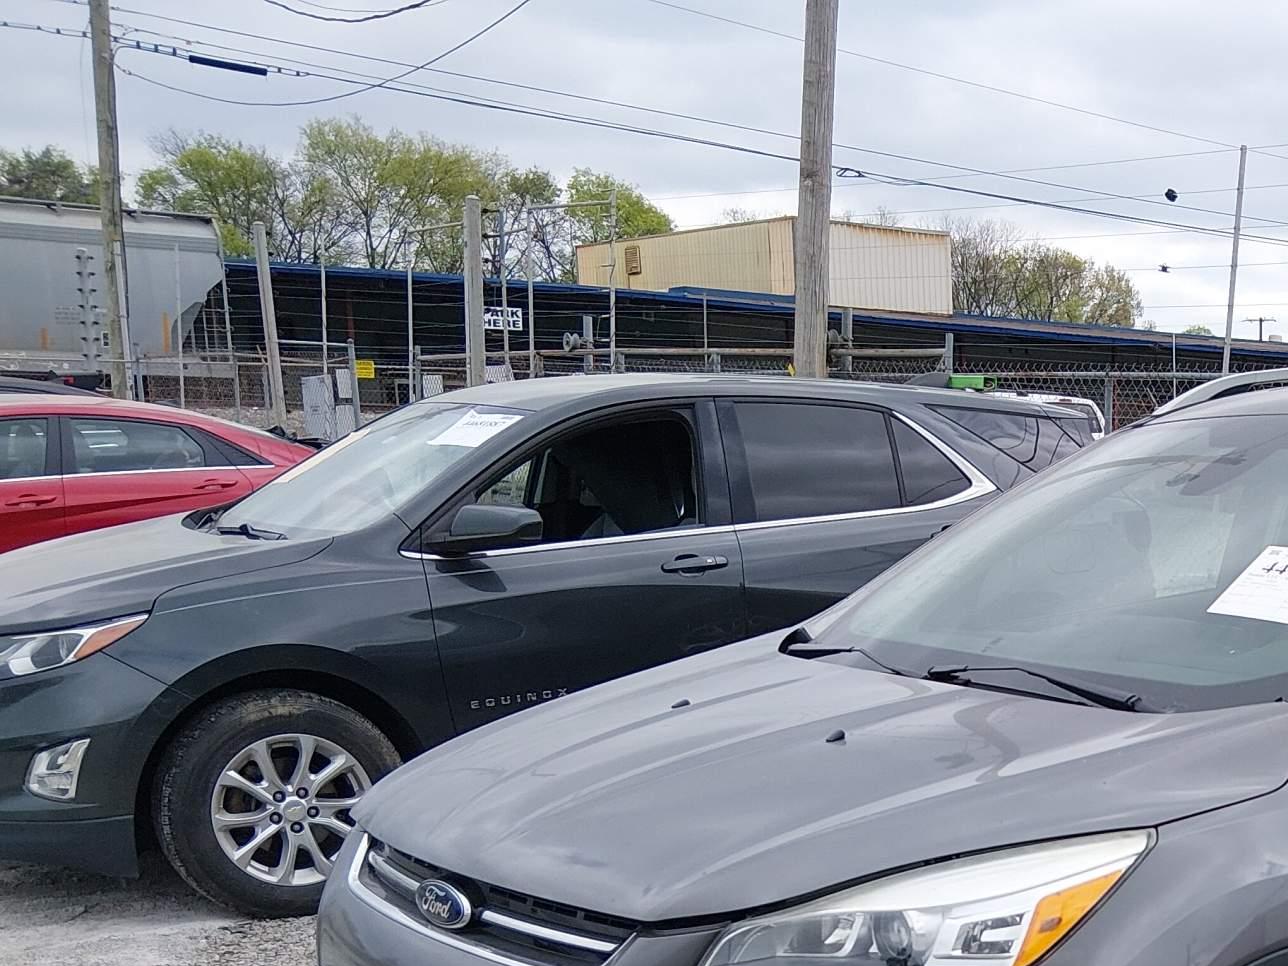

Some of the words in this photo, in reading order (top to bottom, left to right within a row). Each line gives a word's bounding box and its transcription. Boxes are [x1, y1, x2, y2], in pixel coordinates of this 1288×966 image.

[484, 308, 520, 318] PARK
[484, 318, 521, 328] HERE
[470, 688, 568, 709] EQUINOX
[422, 886, 452, 919] Ford
